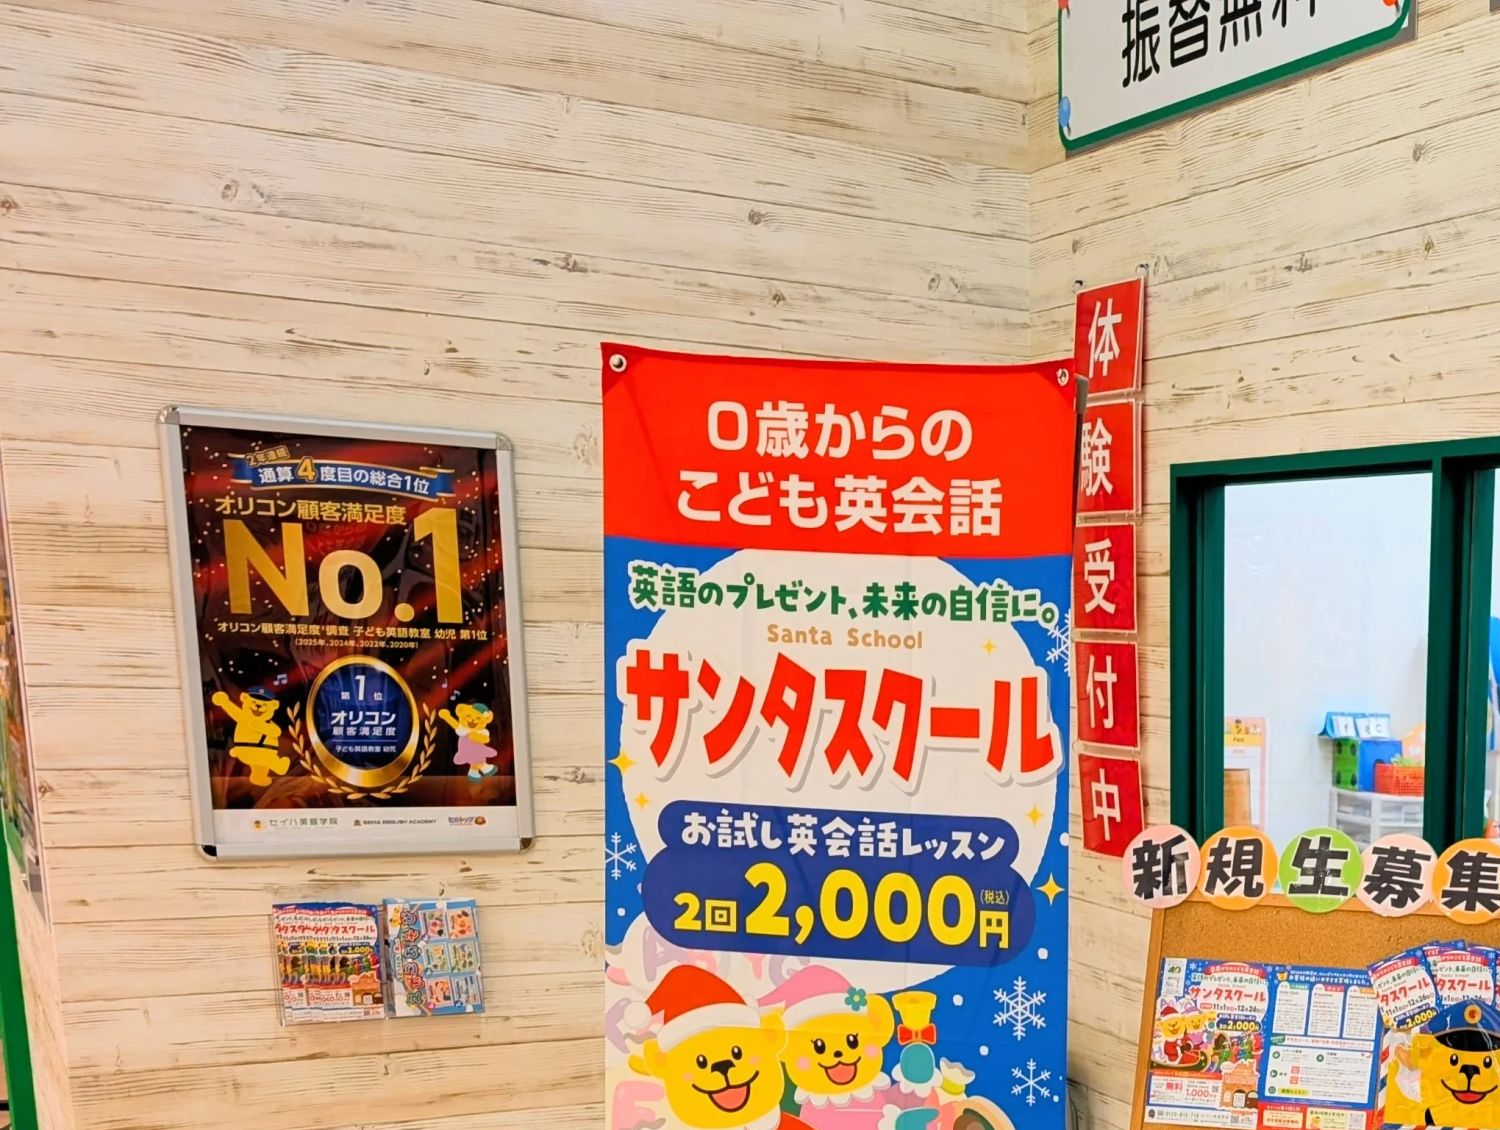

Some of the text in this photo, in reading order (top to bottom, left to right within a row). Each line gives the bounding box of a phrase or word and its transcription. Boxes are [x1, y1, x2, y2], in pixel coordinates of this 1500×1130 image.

[707, 399, 972, 462] 0歳からの
[258, 456, 429, 495] 通算4度目の総合1位
[215, 497, 406, 525] オリコン顧客満足度
[677, 469, 1002, 537] こども英会話
[223, 507, 463, 624] No.1
[631, 563, 1055, 624] 英語のプレゼント、未来の自信に。
[353, 626, 431, 640] 子ども英語教室
[435, 628, 456, 640] 幼児
[460, 629, 487, 641] 第1位
[767, 623, 924, 650] Santa School
[331, 711, 396, 725] オリコン
[333, 726, 396, 736] 顧客満足度
[626, 649, 1055, 782] サンタスクール
[680, 808, 1005, 860] お試し英会話レッスン
[1189, 986, 1266, 1002] サンタスクール
